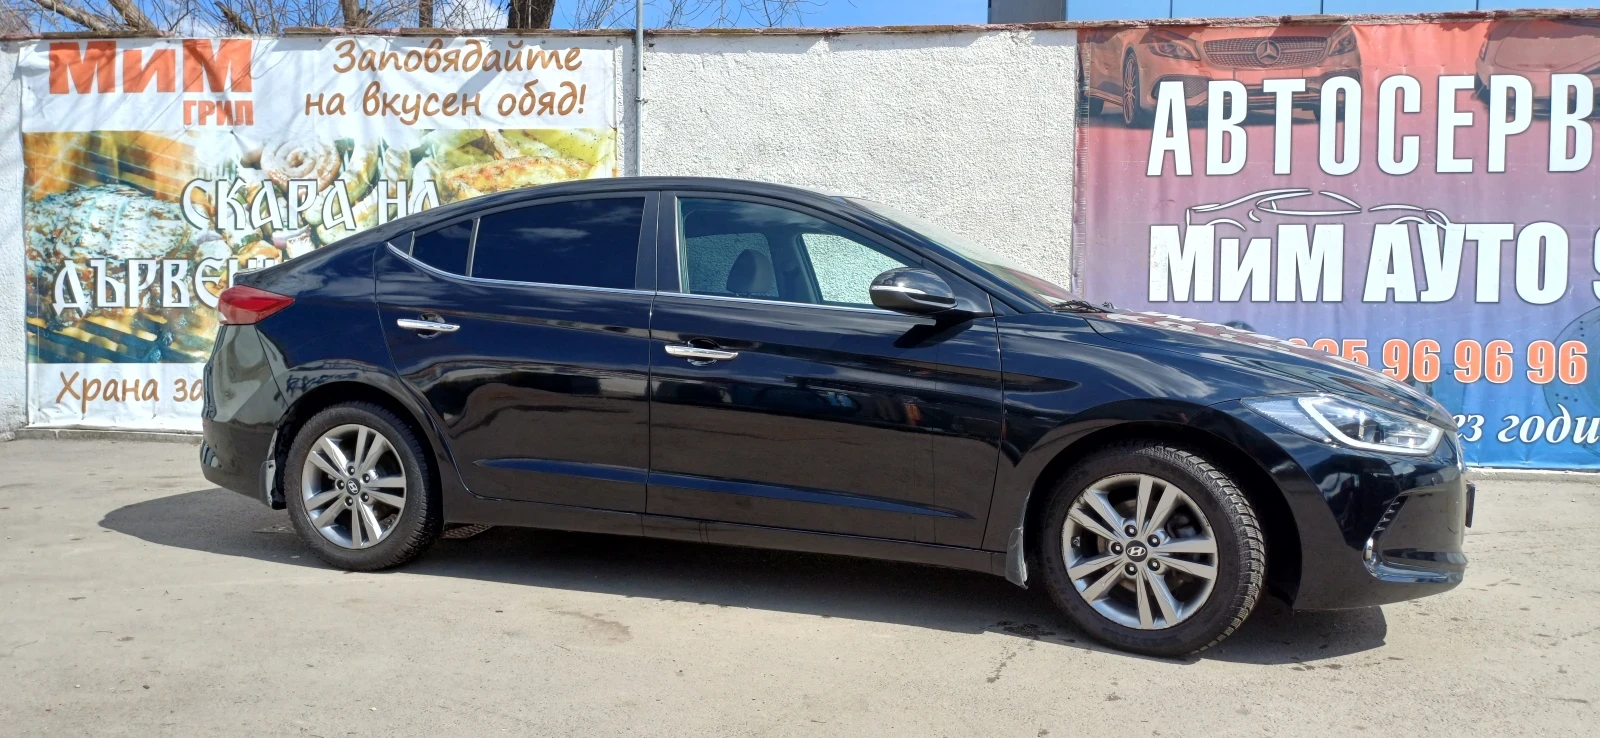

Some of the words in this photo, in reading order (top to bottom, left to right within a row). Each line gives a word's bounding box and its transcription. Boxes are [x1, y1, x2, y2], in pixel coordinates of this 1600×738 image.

[49, 38, 253, 94] МиМ
[333, 37, 583, 74] Заповядайте
[183, 99, 254, 126] ГРИЛ
[304, 92, 346, 116] на
[362, 80, 482, 126] вкусен
[497, 78, 587, 116] обяд!
[1146, 74, 1595, 176] АВТОСЕРВ
[180, 178, 357, 231] СКАРА
[1148, 223, 1345, 303] МиМ
[1363, 221, 1570, 304] АУТО
[1381, 338, 1441, 384] 96
[1453, 339, 1514, 384] 96
[1526, 339, 1588, 385] 96
[56, 371, 160, 413] Храна
[1497, 403, 1600, 444] годи
